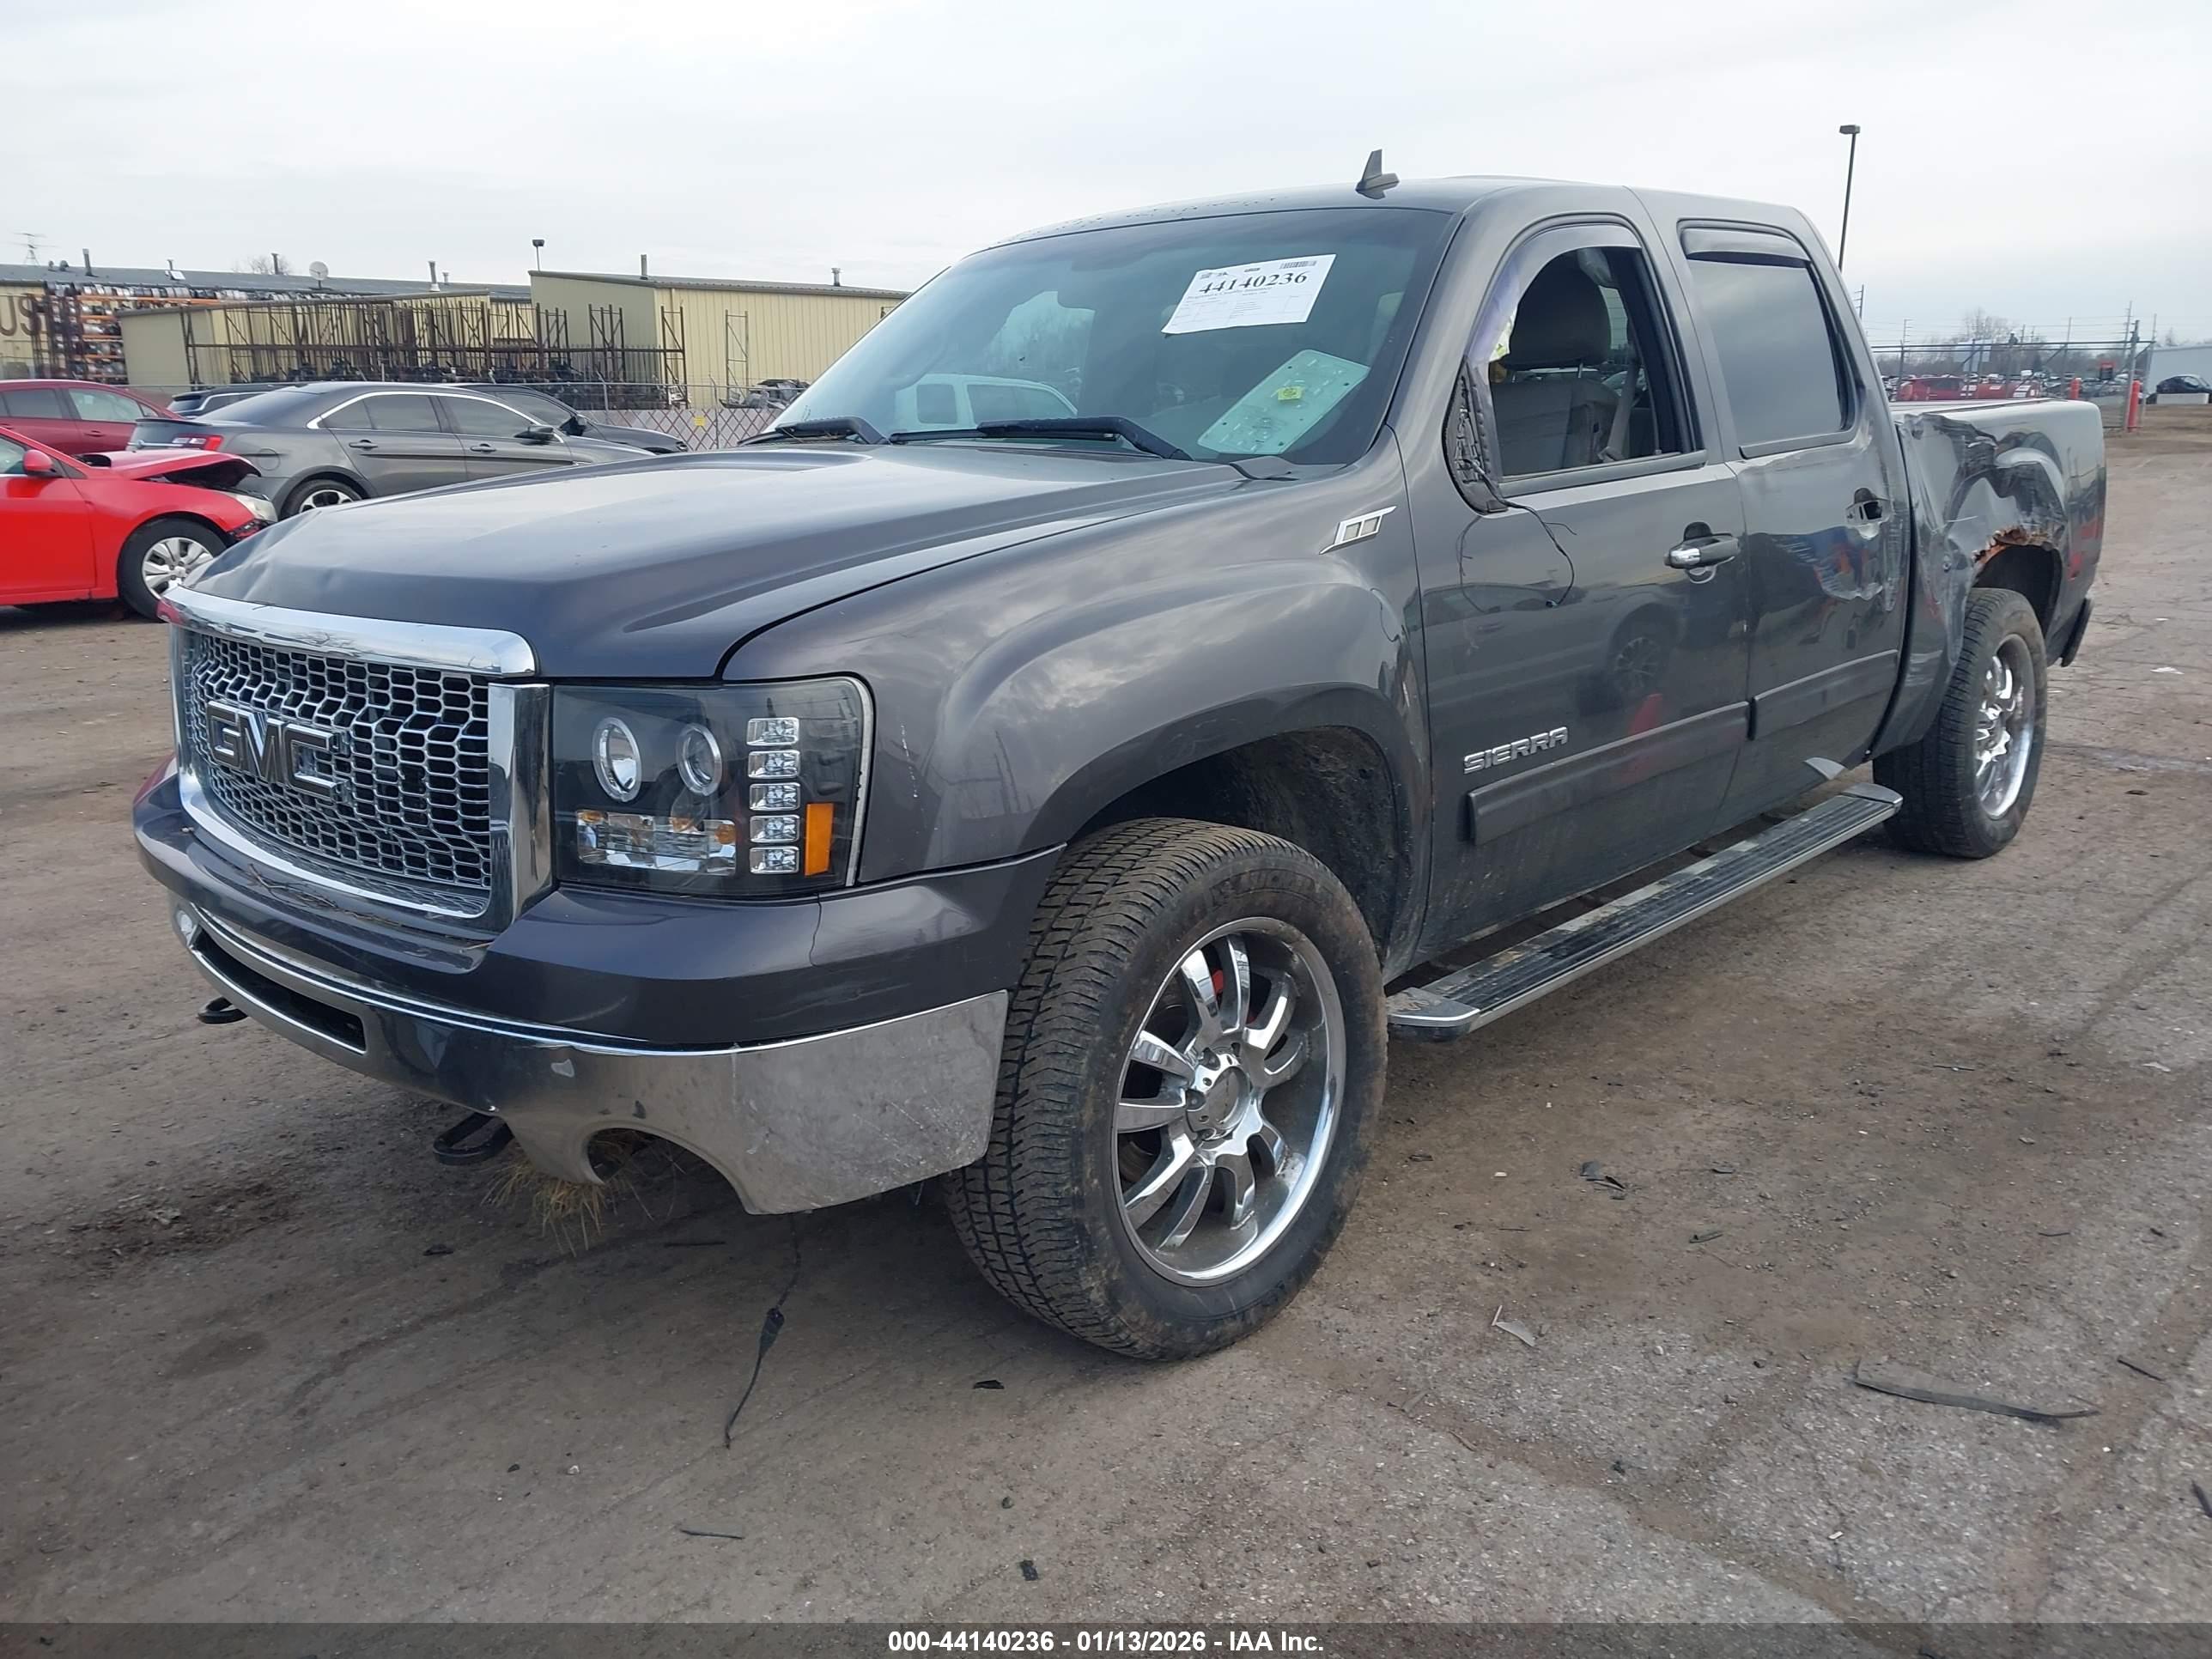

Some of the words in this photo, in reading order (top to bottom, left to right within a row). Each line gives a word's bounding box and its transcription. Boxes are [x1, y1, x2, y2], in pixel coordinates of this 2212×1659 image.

[1199, 271, 1309, 294] 44140236
[206, 701, 345, 802] GMC
[1464, 726, 1568, 774] SIERRA
